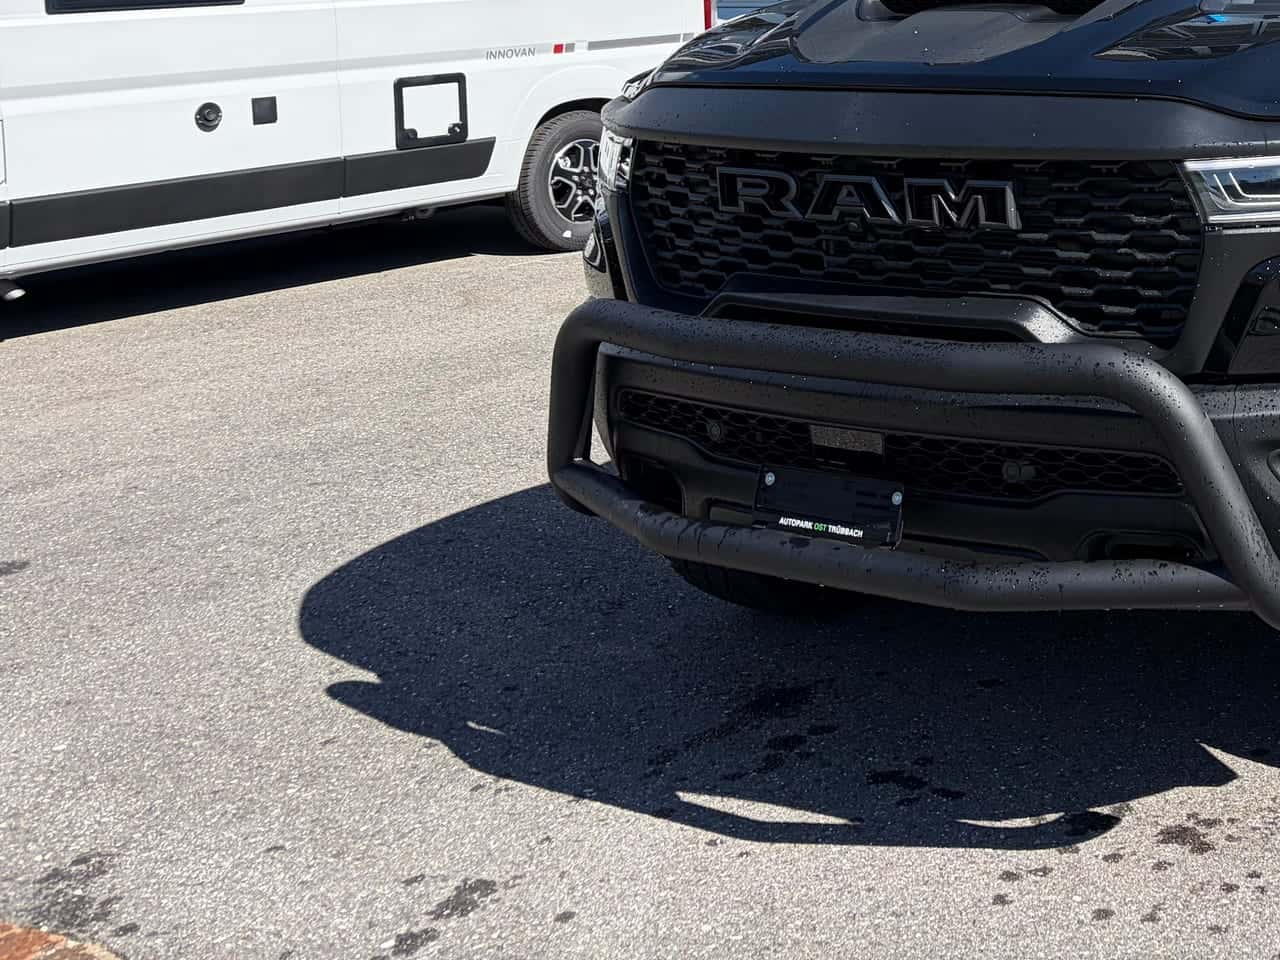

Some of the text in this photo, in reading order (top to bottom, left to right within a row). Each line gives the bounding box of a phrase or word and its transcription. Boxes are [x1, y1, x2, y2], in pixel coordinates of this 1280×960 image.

[486, 47, 536, 60] INNOVAN
[716, 166, 1022, 230] RAM
[779, 515, 864, 538] AUTOPARK OST TRÜBBACH
